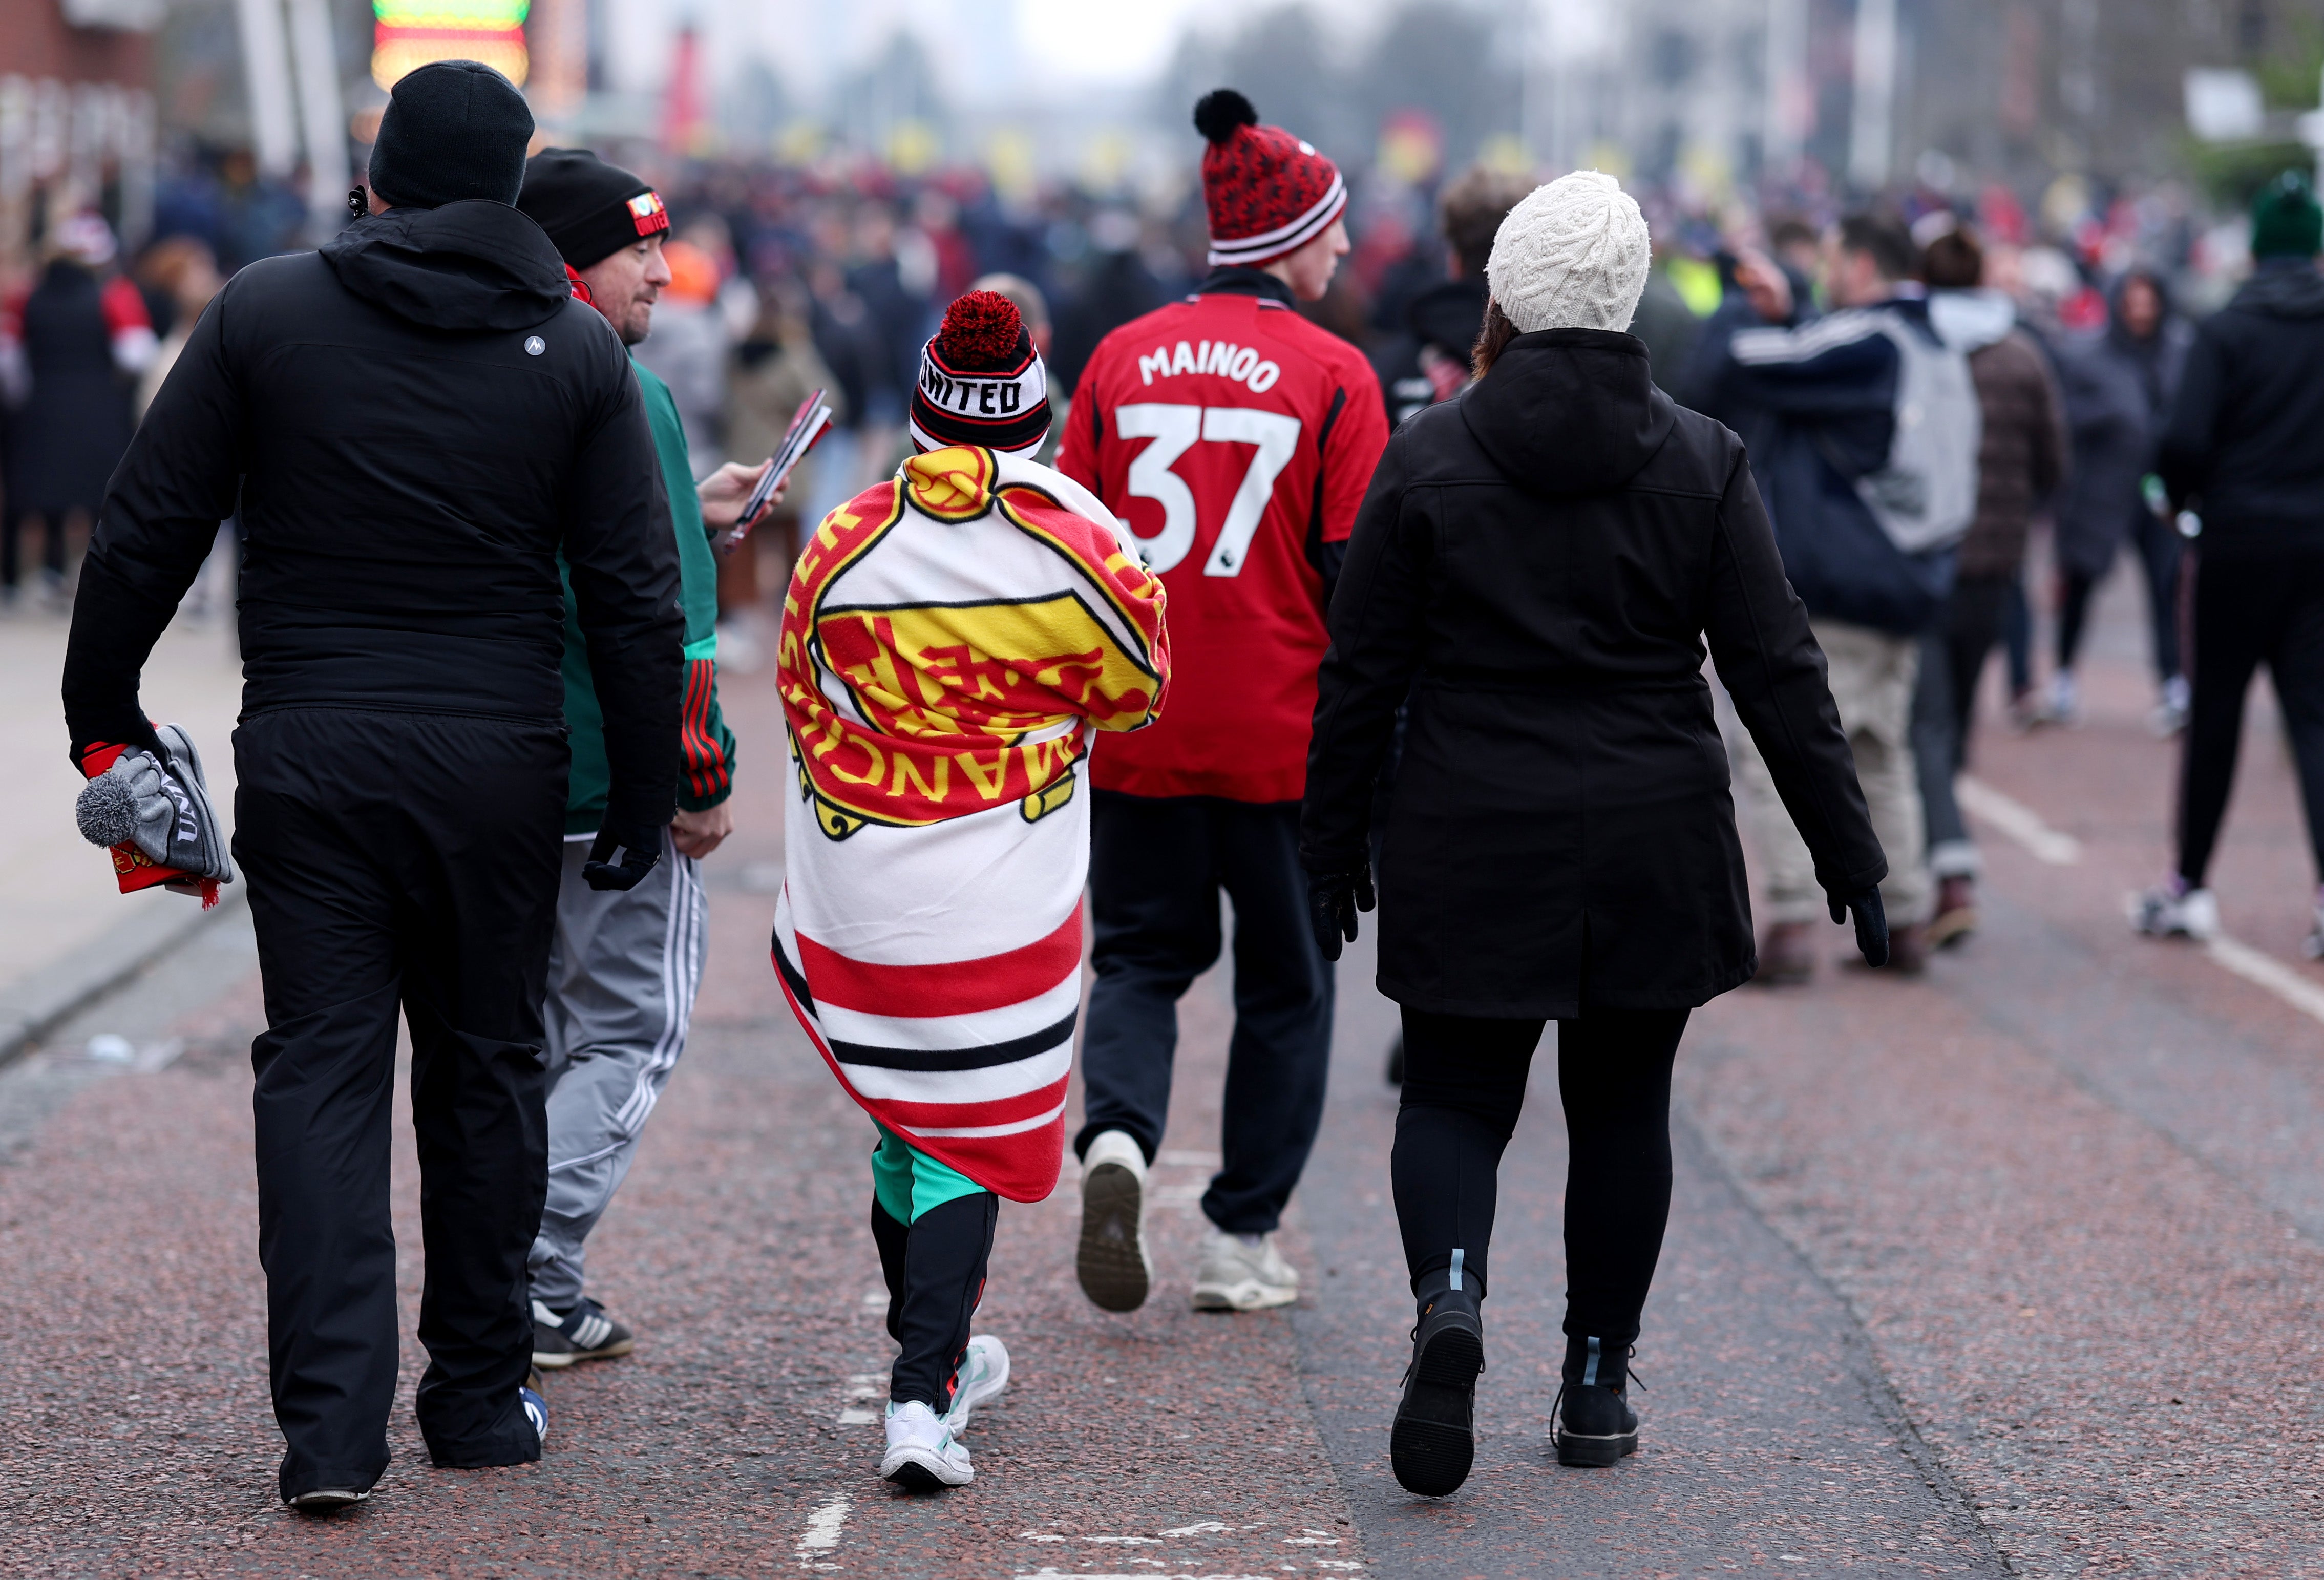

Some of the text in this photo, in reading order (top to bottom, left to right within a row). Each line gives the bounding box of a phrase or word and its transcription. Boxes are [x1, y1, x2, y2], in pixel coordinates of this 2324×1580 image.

[921, 350, 1021, 414] UNITED
[1138, 340, 1280, 393] MAINOO
[1115, 403, 1302, 577] 37
